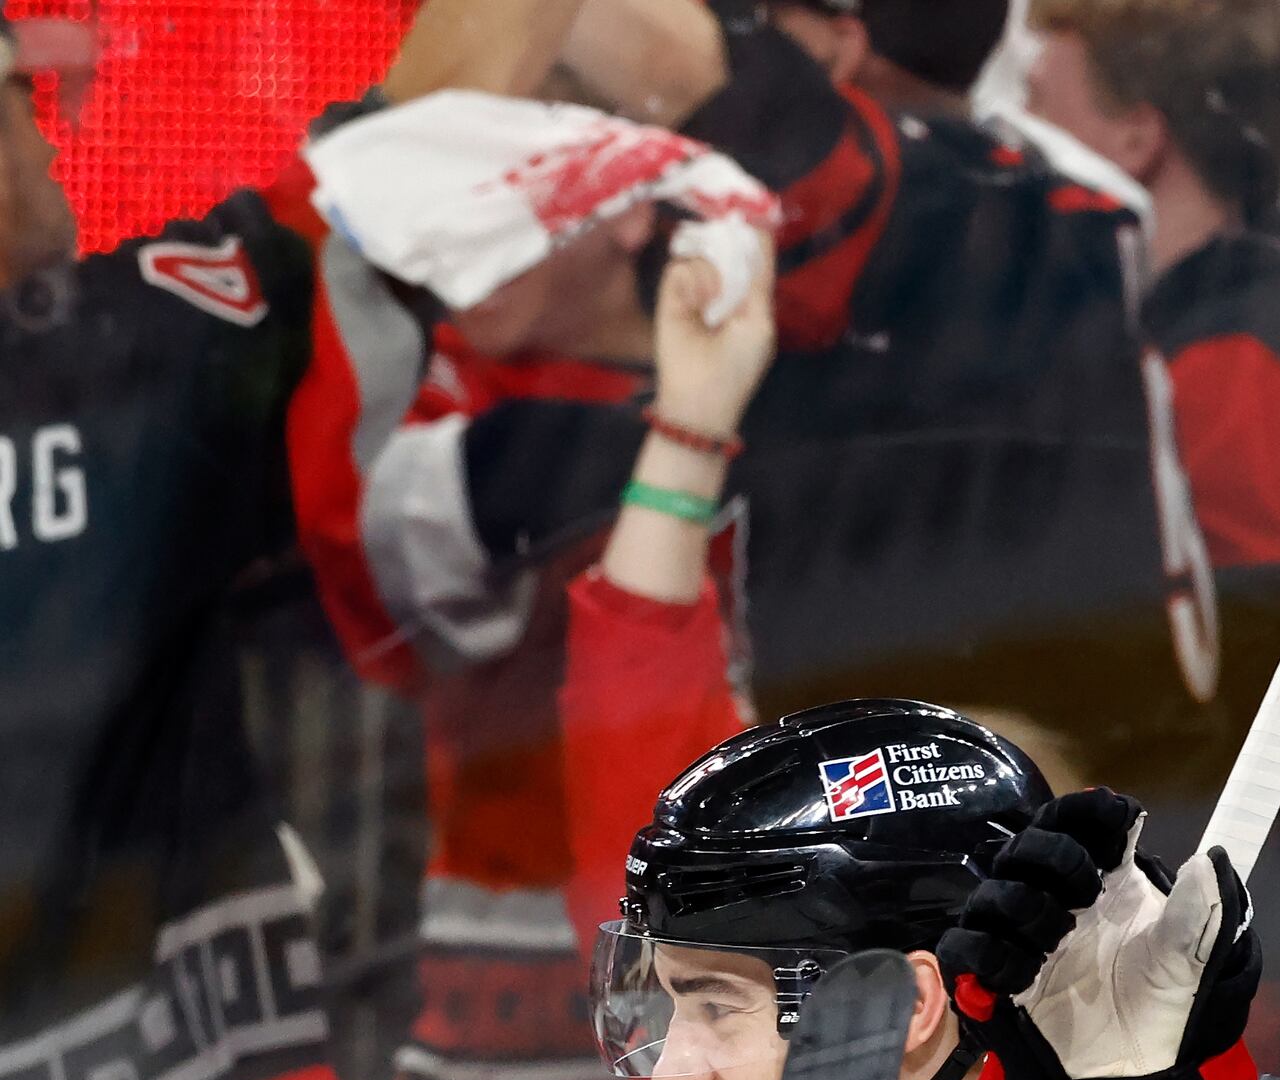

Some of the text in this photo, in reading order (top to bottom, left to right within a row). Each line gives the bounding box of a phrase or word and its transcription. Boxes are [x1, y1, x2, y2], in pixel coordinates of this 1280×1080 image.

[885, 742, 942, 764] First
[893, 762, 985, 786] Citizens
[897, 785, 961, 811] Bank
